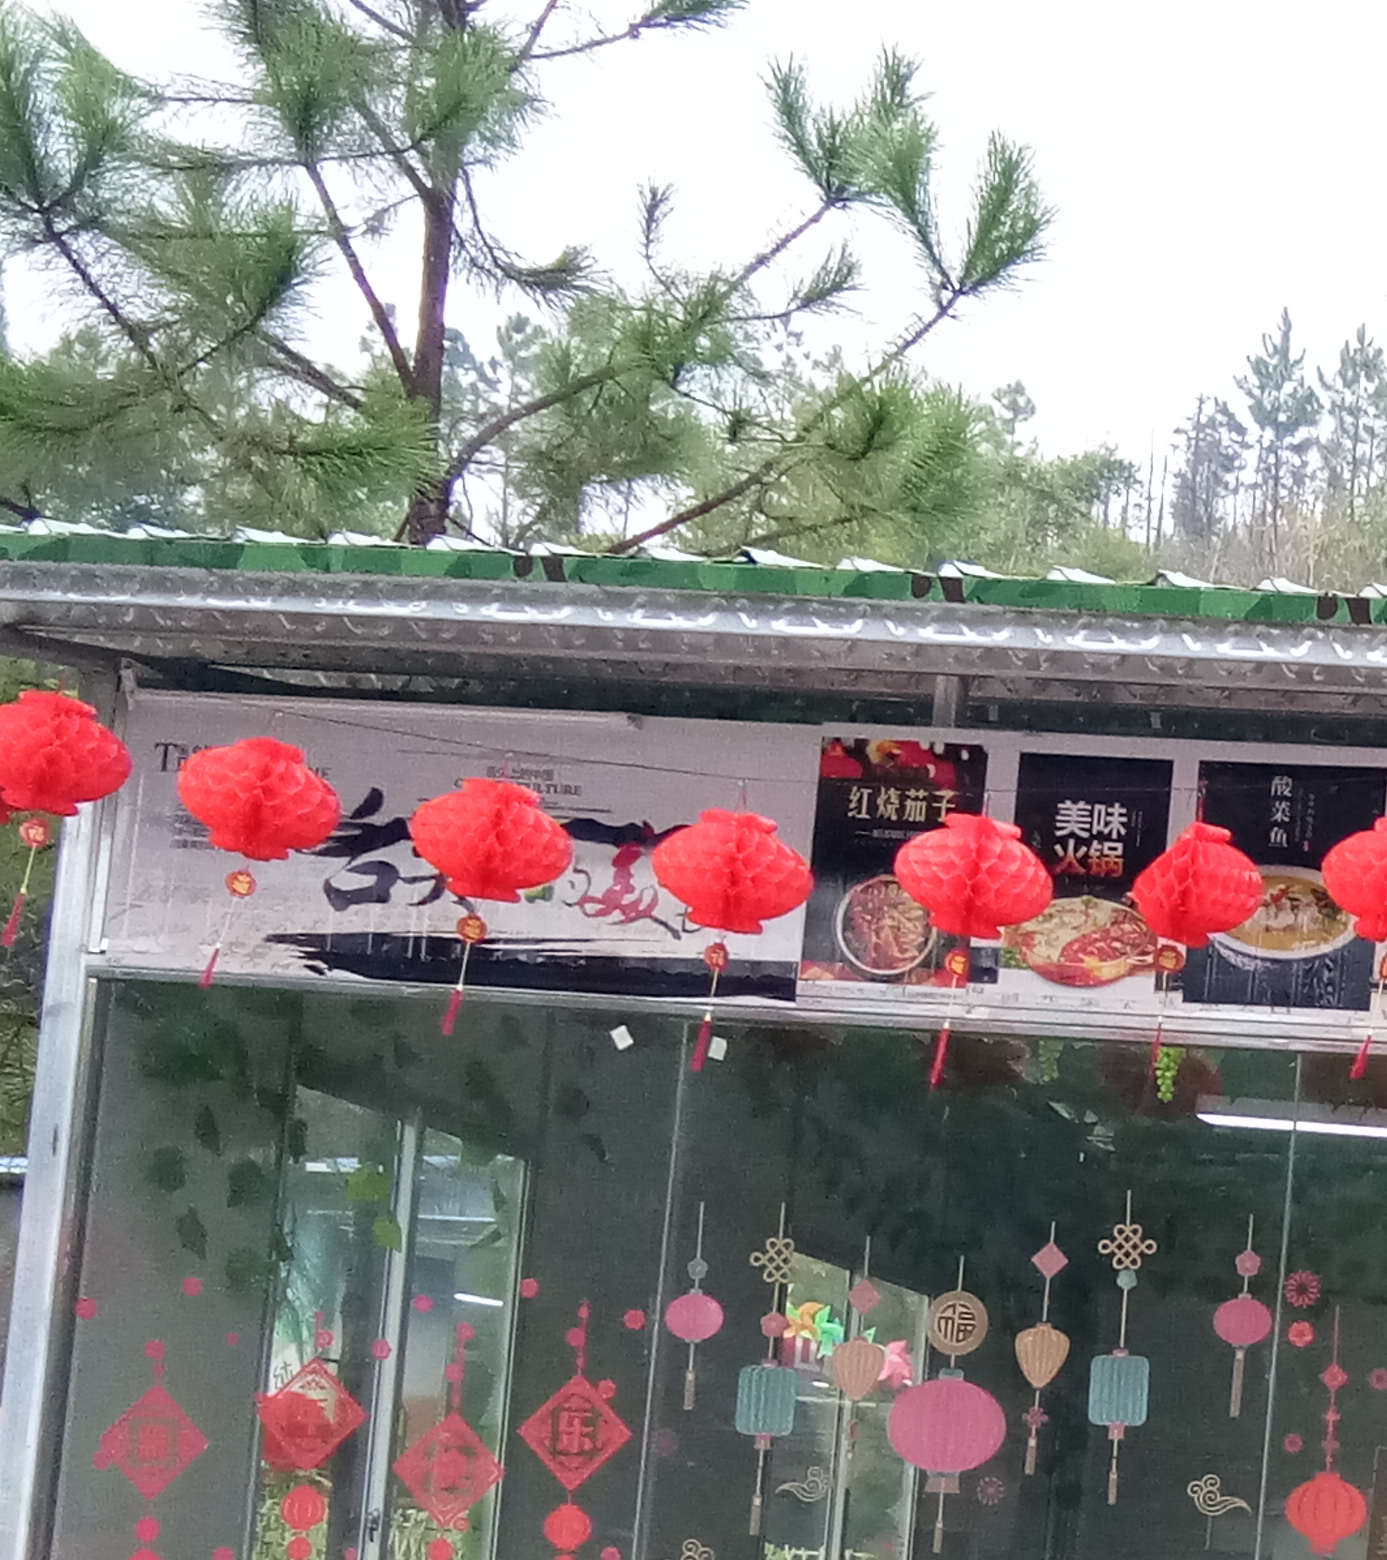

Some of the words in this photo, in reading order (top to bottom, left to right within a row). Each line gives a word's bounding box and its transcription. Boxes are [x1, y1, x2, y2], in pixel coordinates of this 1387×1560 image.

[847, 785, 959, 823] 红烧茄子
[1053, 800, 1129, 839] 美味
[1268, 775, 1293, 848] 酸菜鱼
[1053, 841, 1125, 877] 火锅
[937, 1302, 977, 1344] 福
